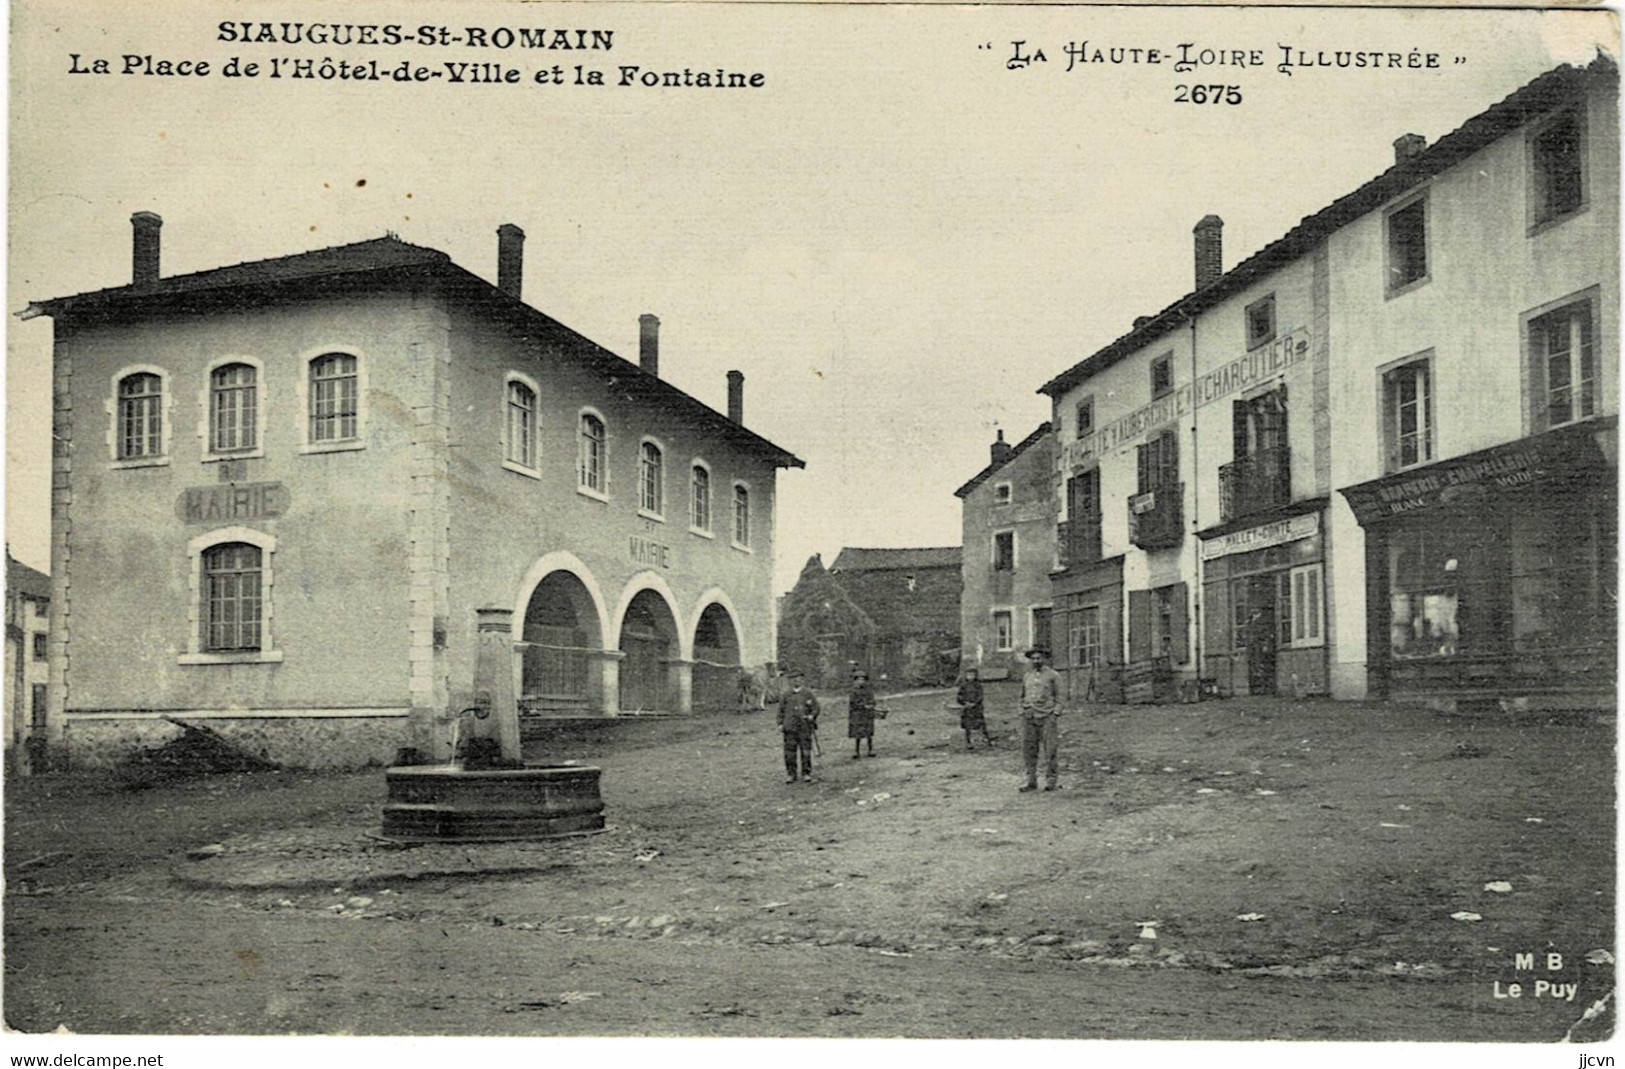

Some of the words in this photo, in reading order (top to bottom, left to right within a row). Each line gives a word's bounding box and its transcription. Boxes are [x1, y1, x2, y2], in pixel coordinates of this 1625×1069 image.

[1204, 336, 1294, 401] CHARCUTIER
[185, 484, 280, 522] MAIRIE
[629, 536, 670, 570] MAIRIE
